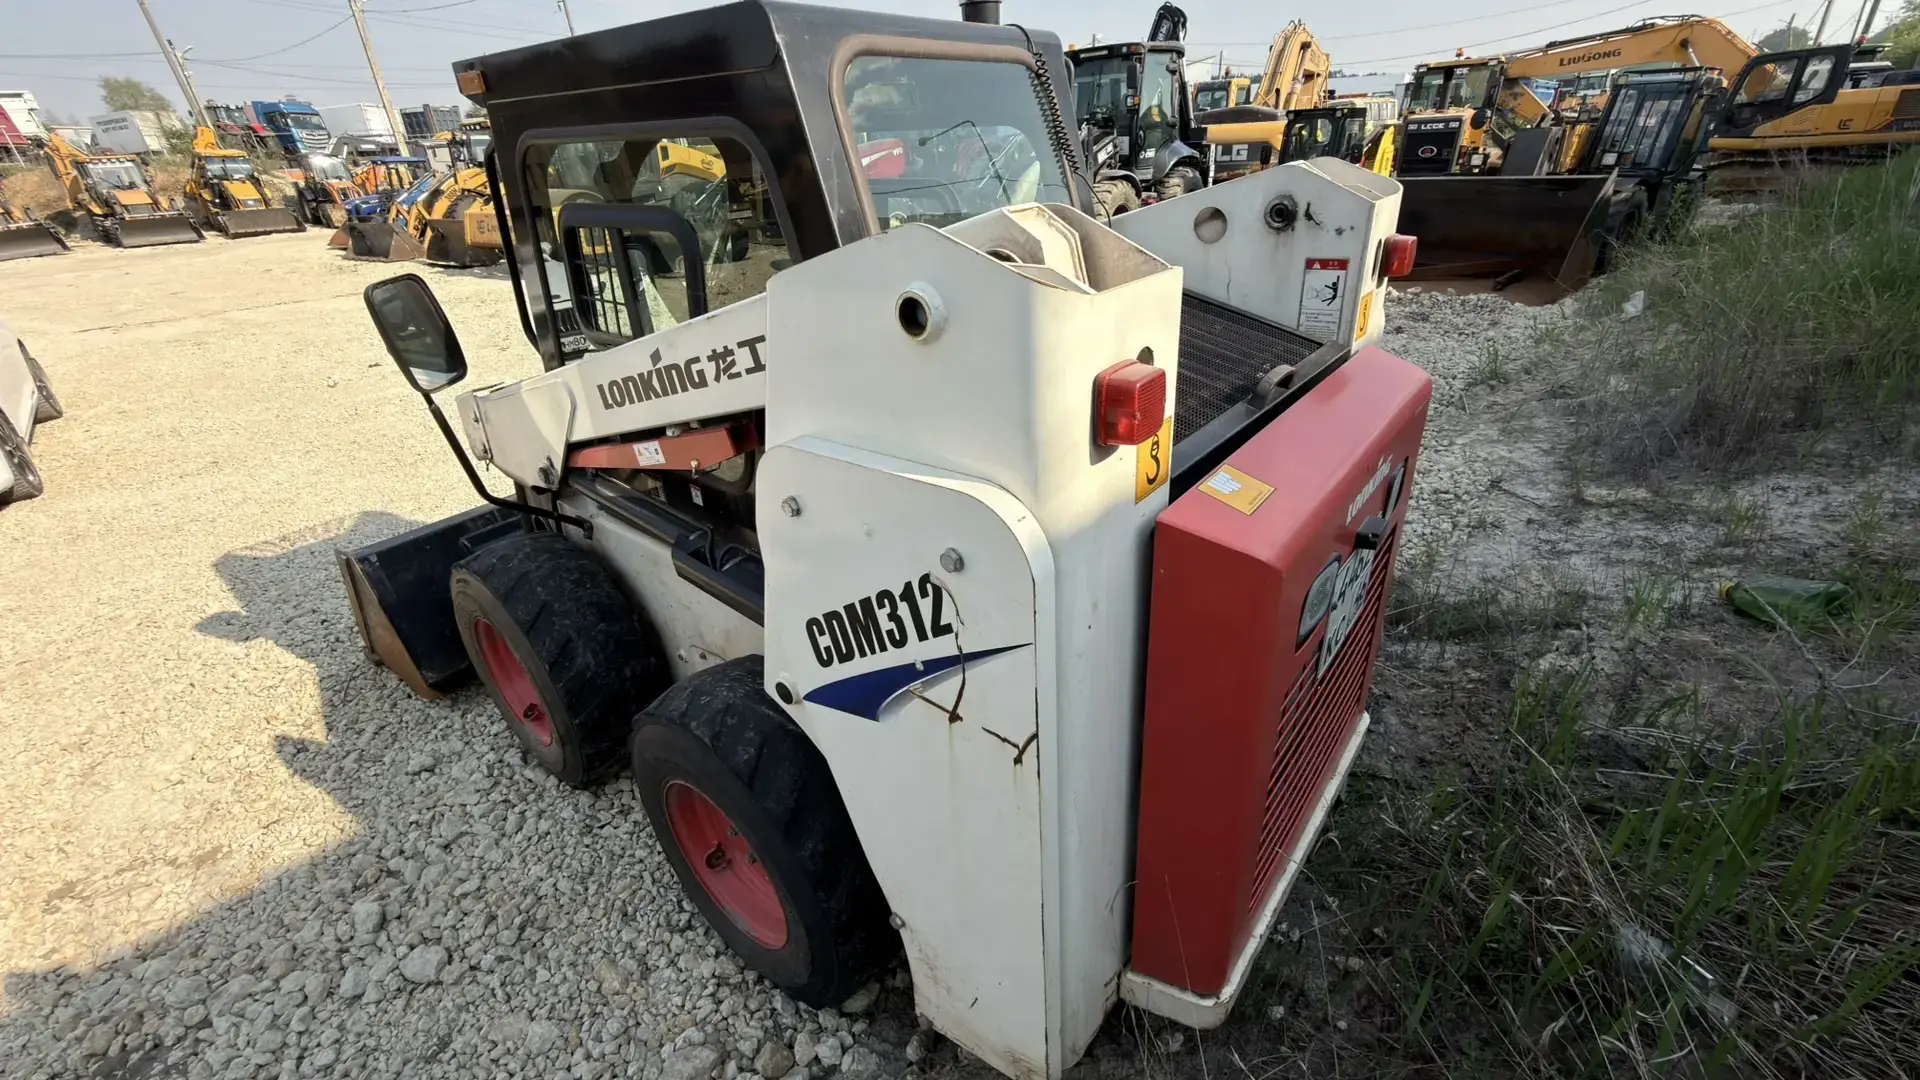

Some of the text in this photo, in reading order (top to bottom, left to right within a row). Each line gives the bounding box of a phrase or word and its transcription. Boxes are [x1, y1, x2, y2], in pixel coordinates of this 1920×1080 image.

[1559, 48, 1622, 67] LIUGONG
[597, 334, 767, 411] LONKING 龙工
[805, 572, 955, 669] CDM312
